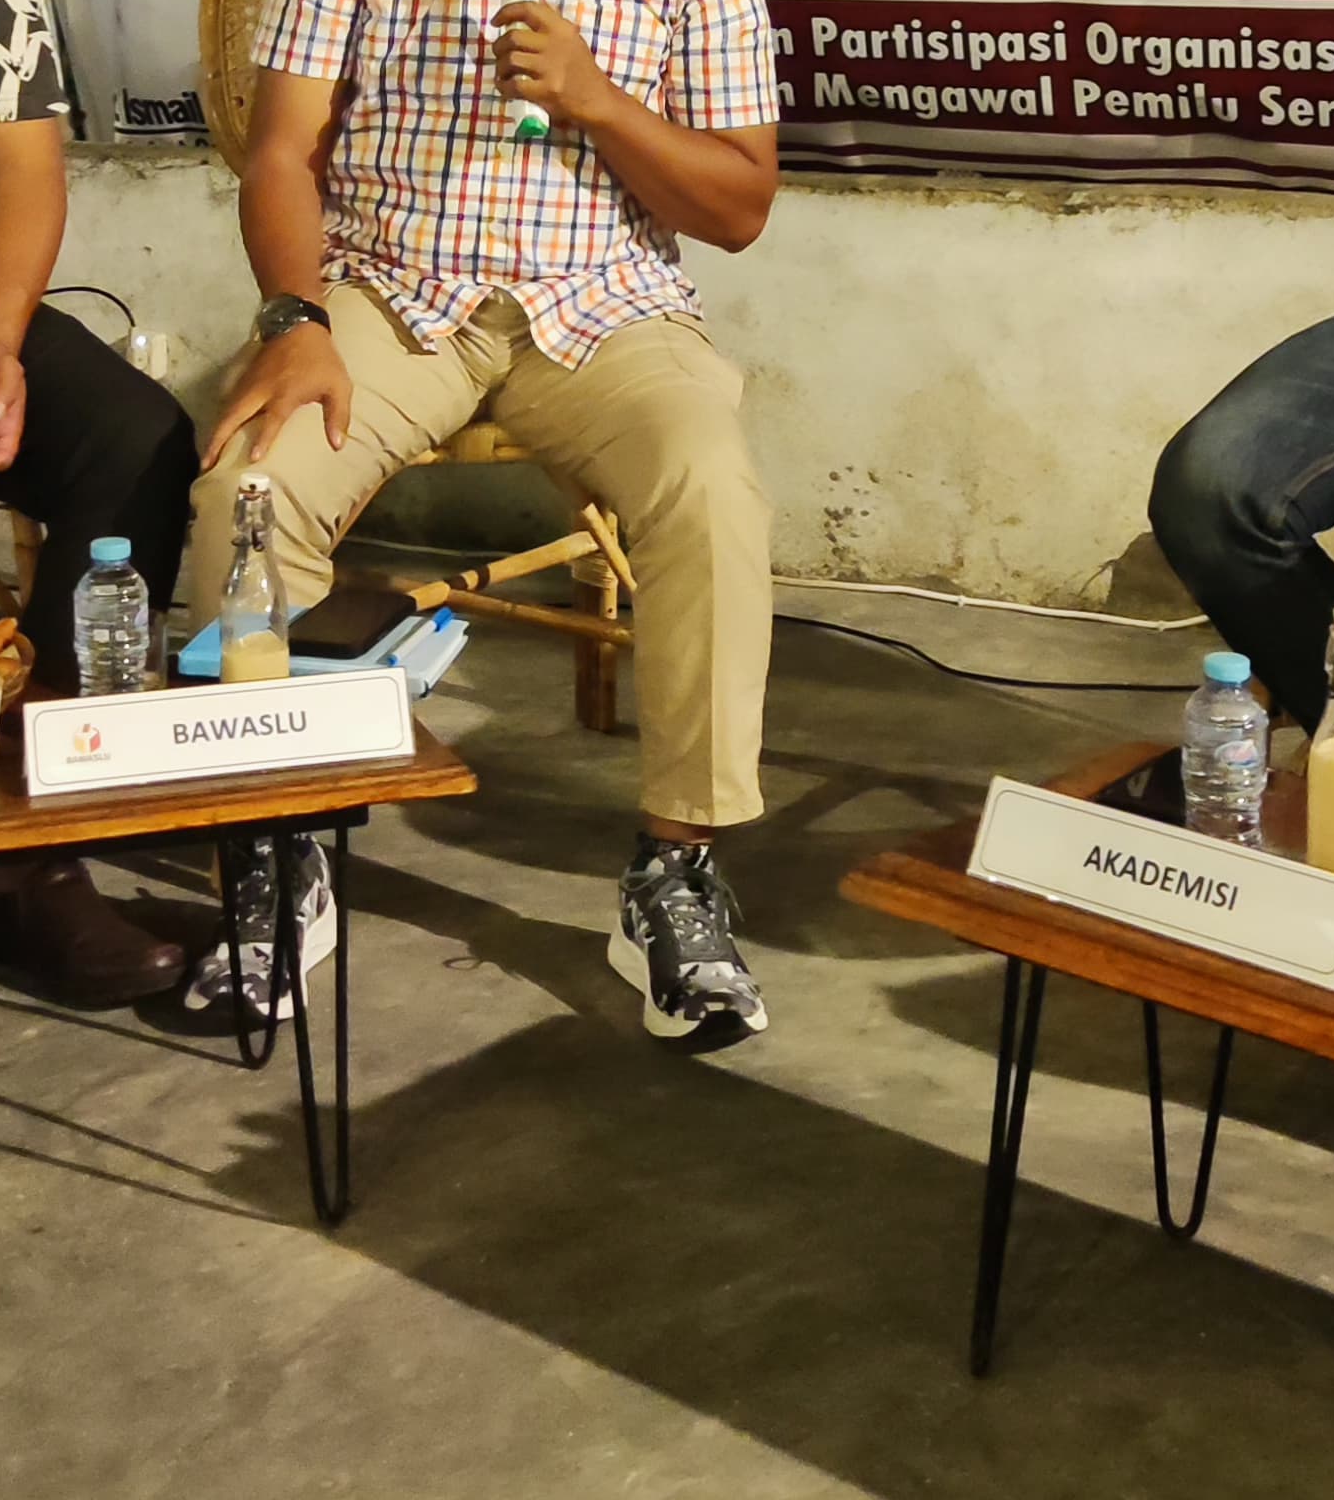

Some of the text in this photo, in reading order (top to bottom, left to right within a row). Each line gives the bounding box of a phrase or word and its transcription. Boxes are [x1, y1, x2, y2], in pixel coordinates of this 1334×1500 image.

[811, 16, 1067, 71] Partisipasi
[122, 88, 206, 126] Ismail
[813, 72, 1054, 120] Mengawal
[1072, 79, 1239, 123] Pemilu
[172, 710, 308, 745] BAWASLU
[1082, 845, 1239, 912] AKADEMISI
